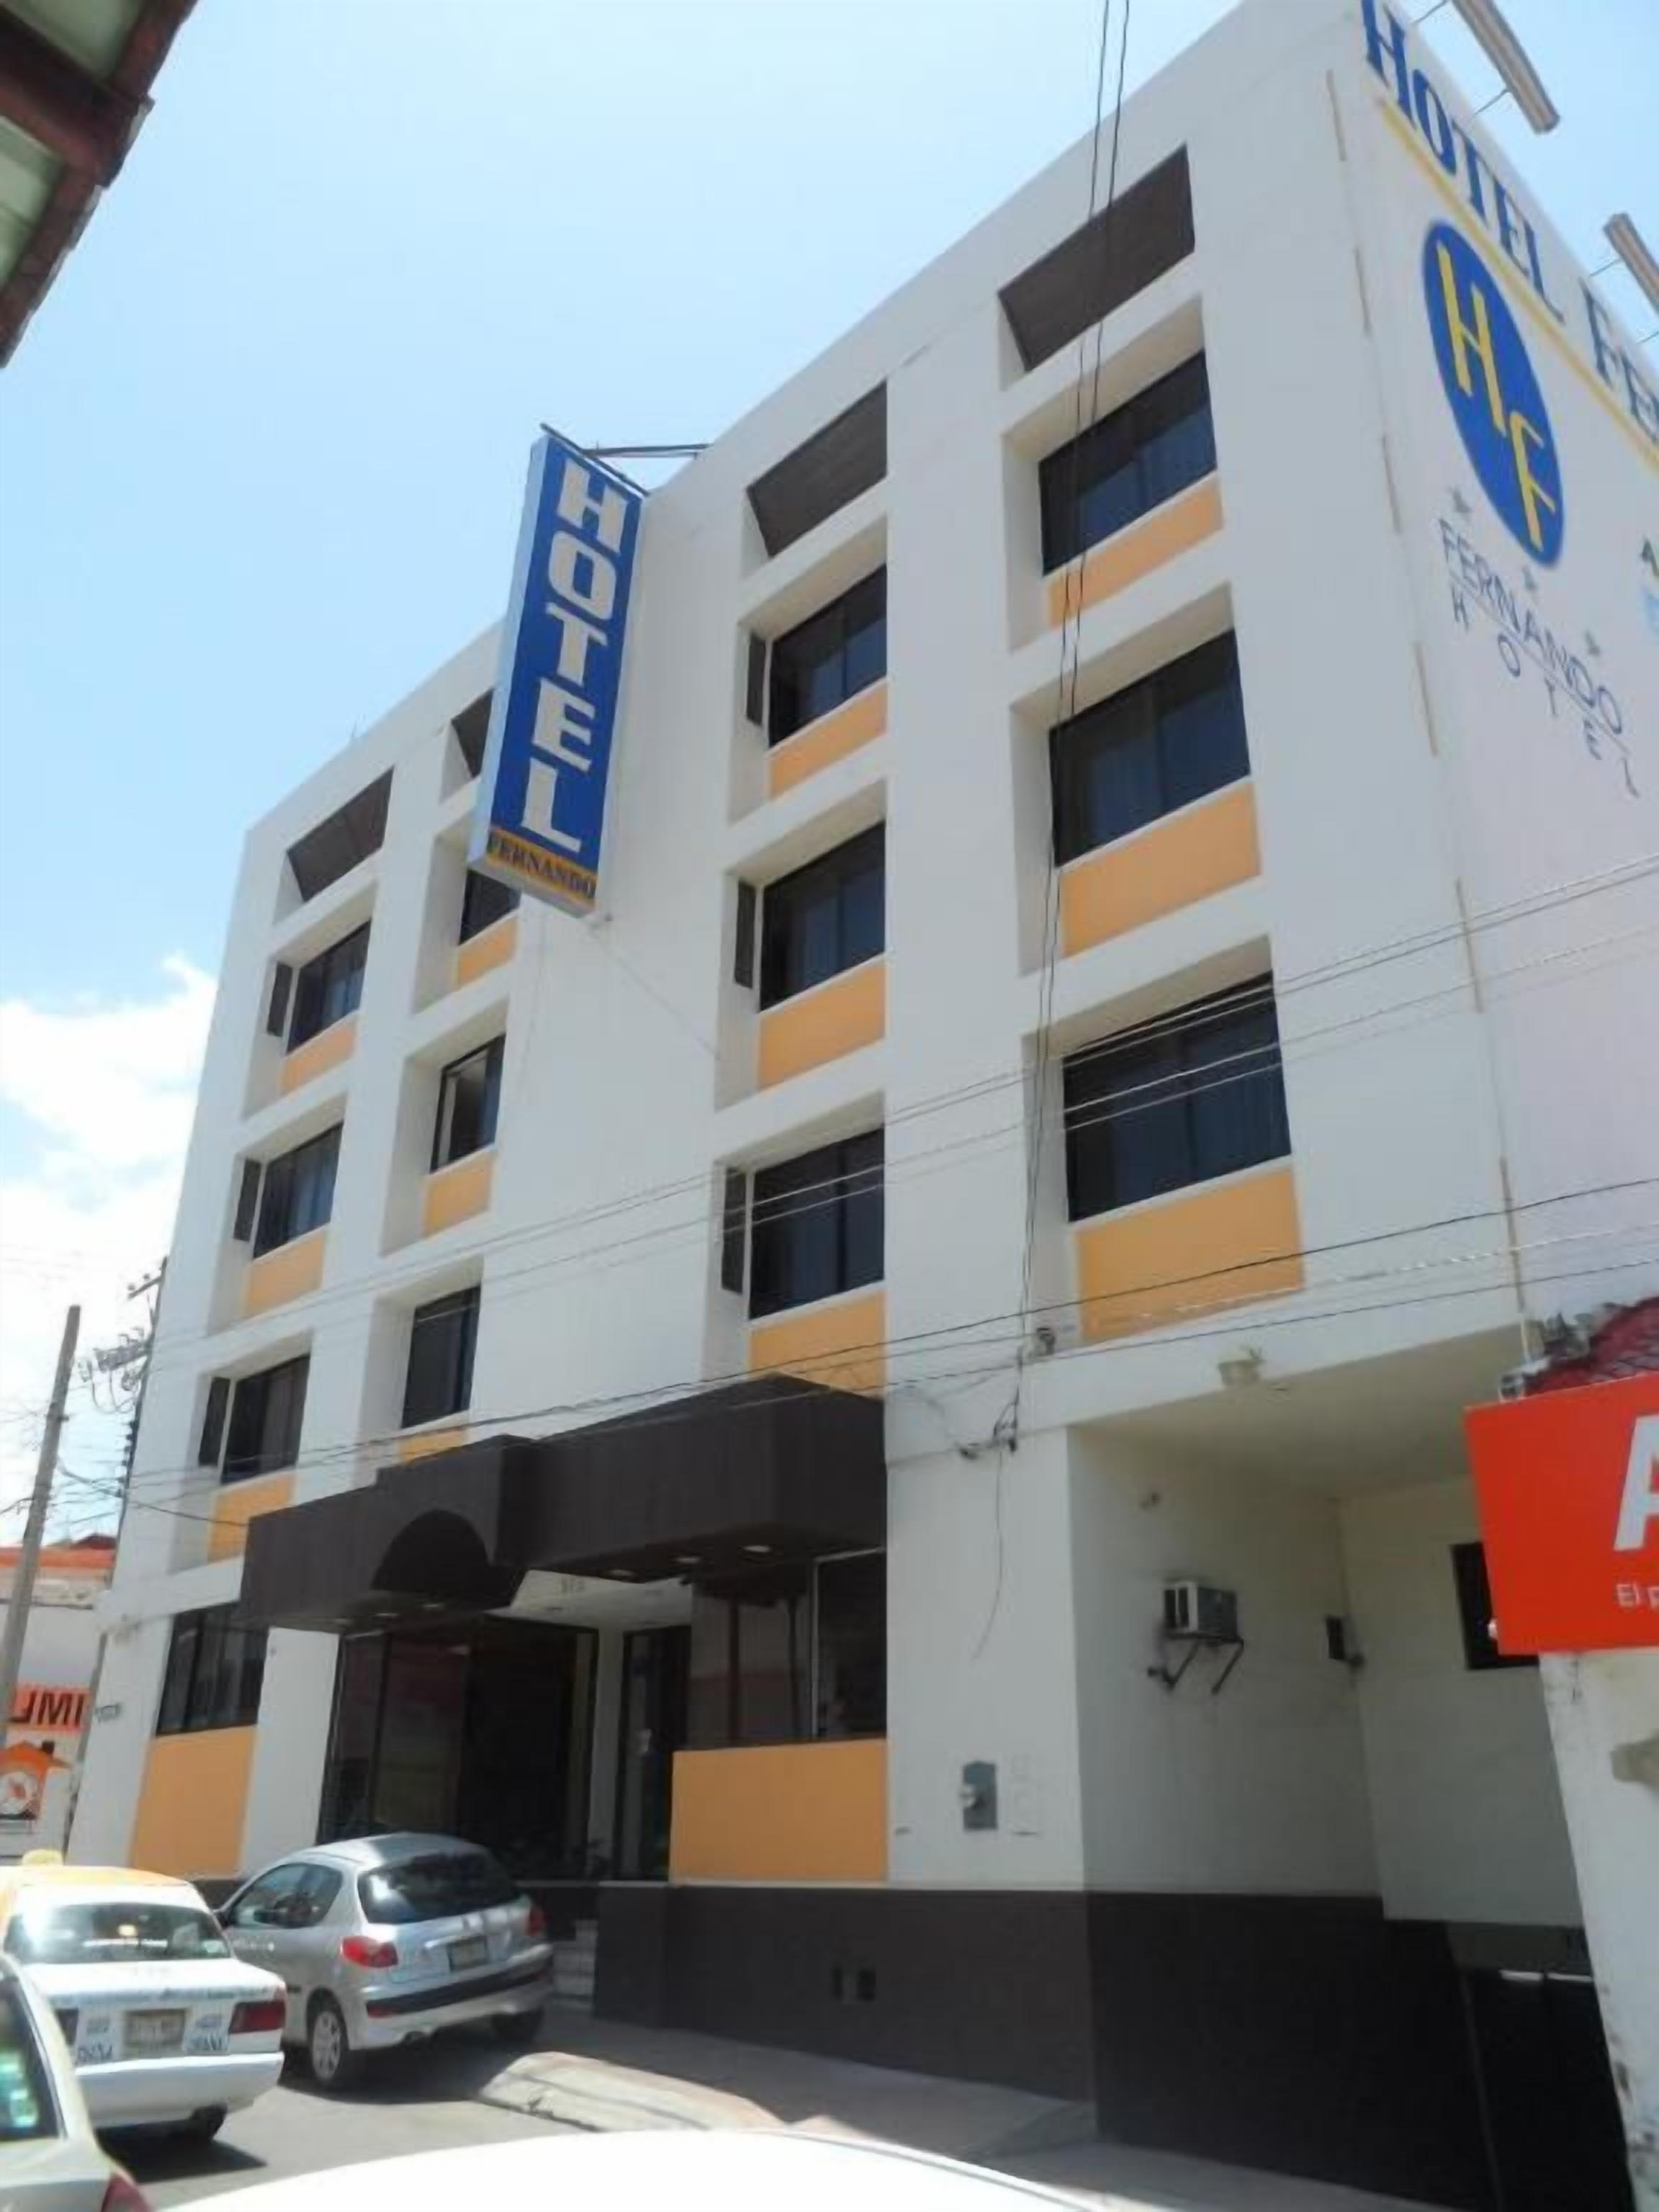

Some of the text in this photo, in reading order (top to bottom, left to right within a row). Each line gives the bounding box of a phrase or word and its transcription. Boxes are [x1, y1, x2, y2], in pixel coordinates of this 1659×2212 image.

[1360, 0, 1565, 325] HOTEL
[1437, 239, 1556, 553] HF
[521, 458, 628, 853] HOTEL
[1439, 518, 1622, 735] FERNANDO
[486, 832, 598, 899] FERNANDO
